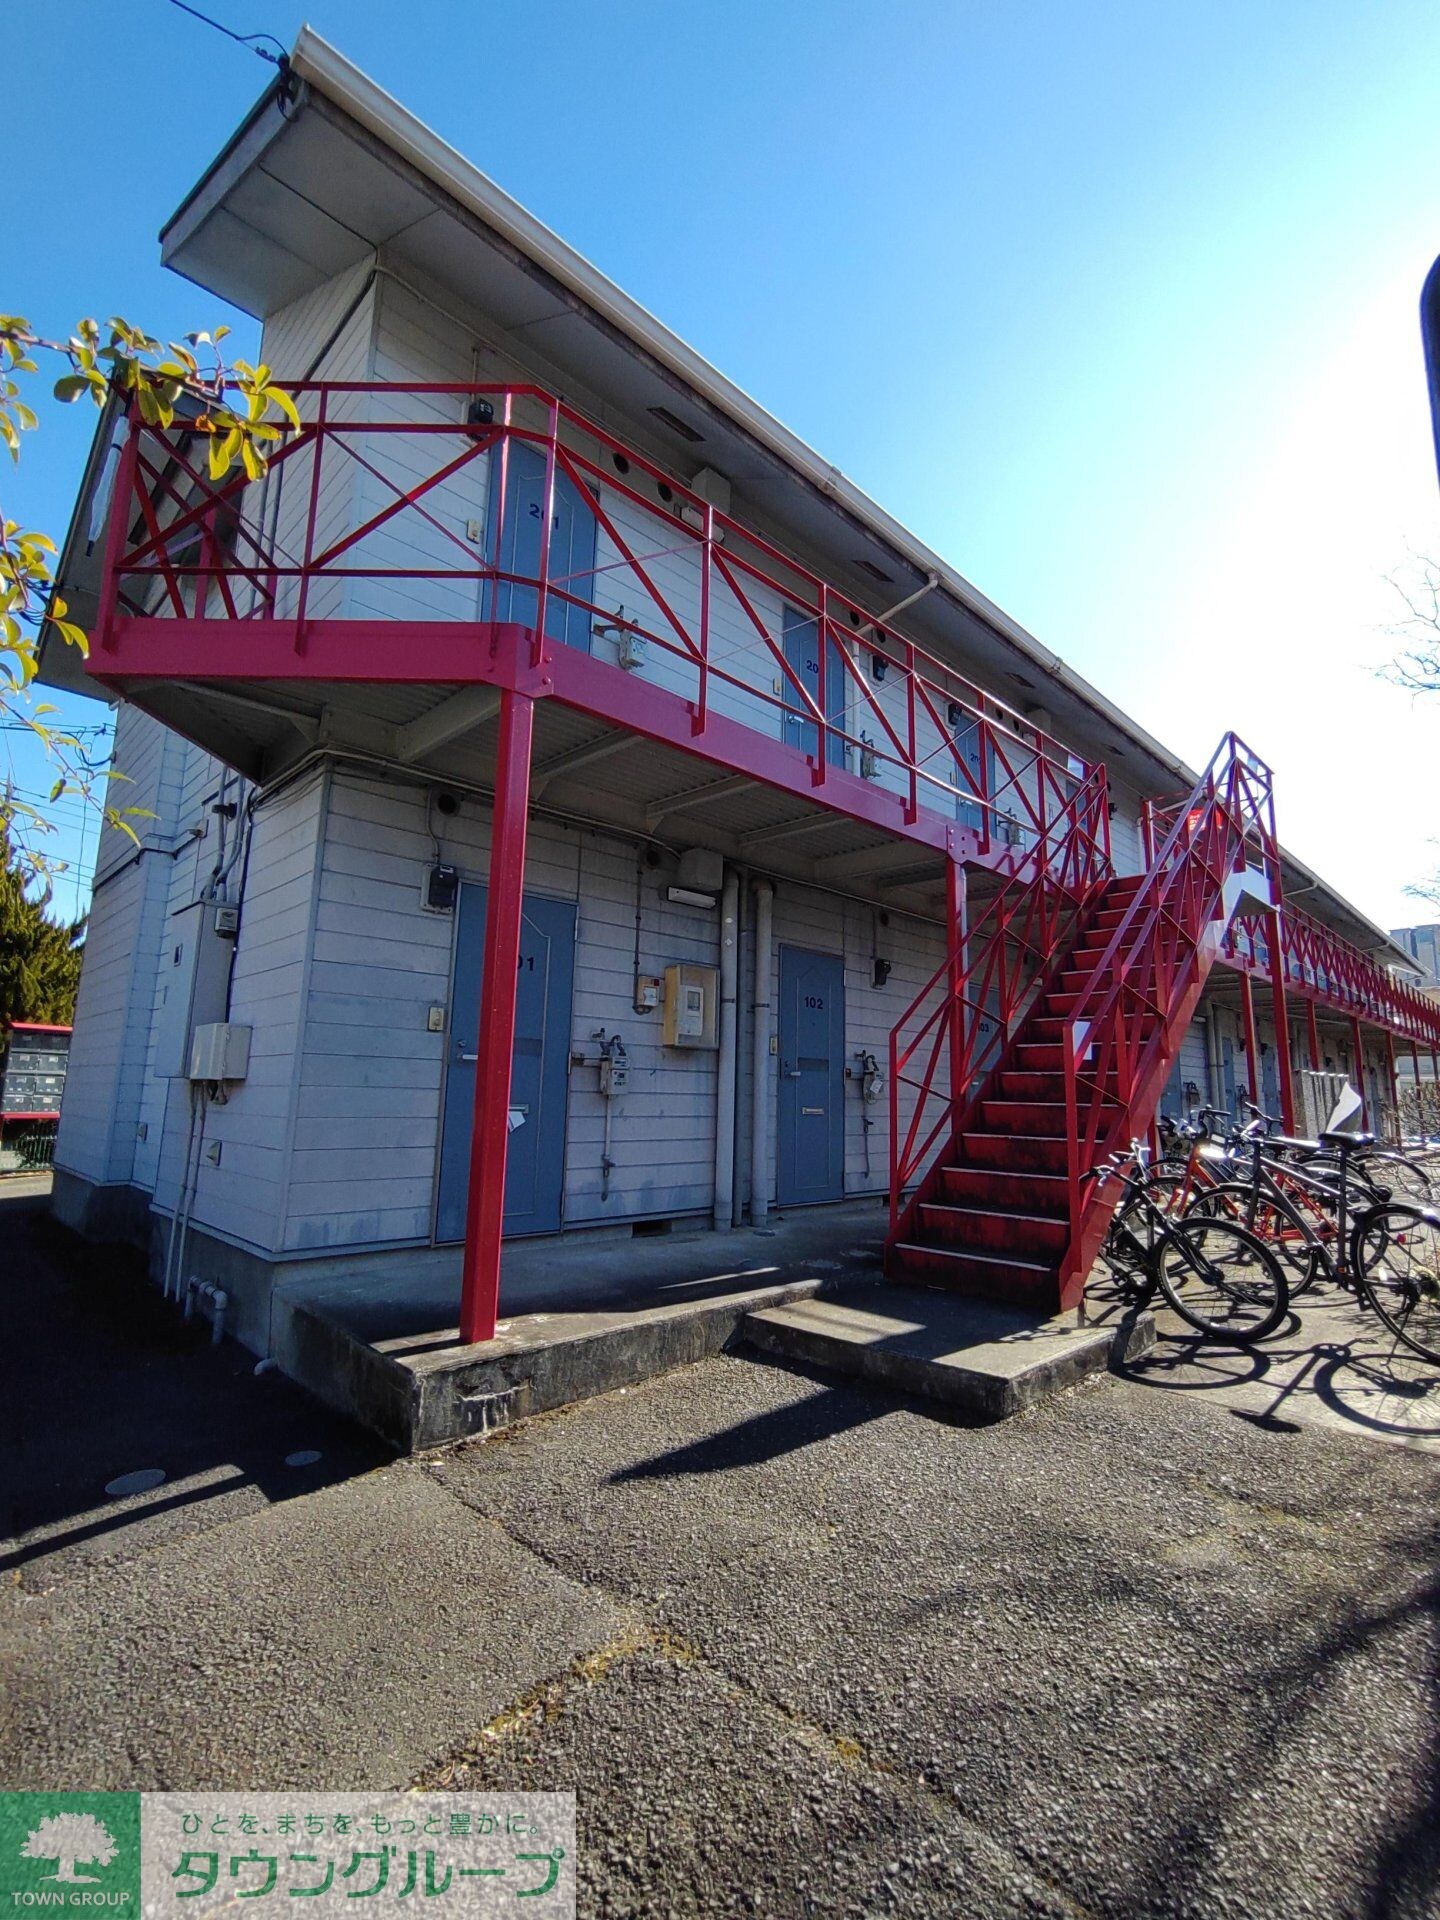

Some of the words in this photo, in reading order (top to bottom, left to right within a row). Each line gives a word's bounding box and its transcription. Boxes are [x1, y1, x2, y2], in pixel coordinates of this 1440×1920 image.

[529, 503, 559, 530] 21
[806, 659, 819, 674] 20
[804, 996, 824, 1010] 102
